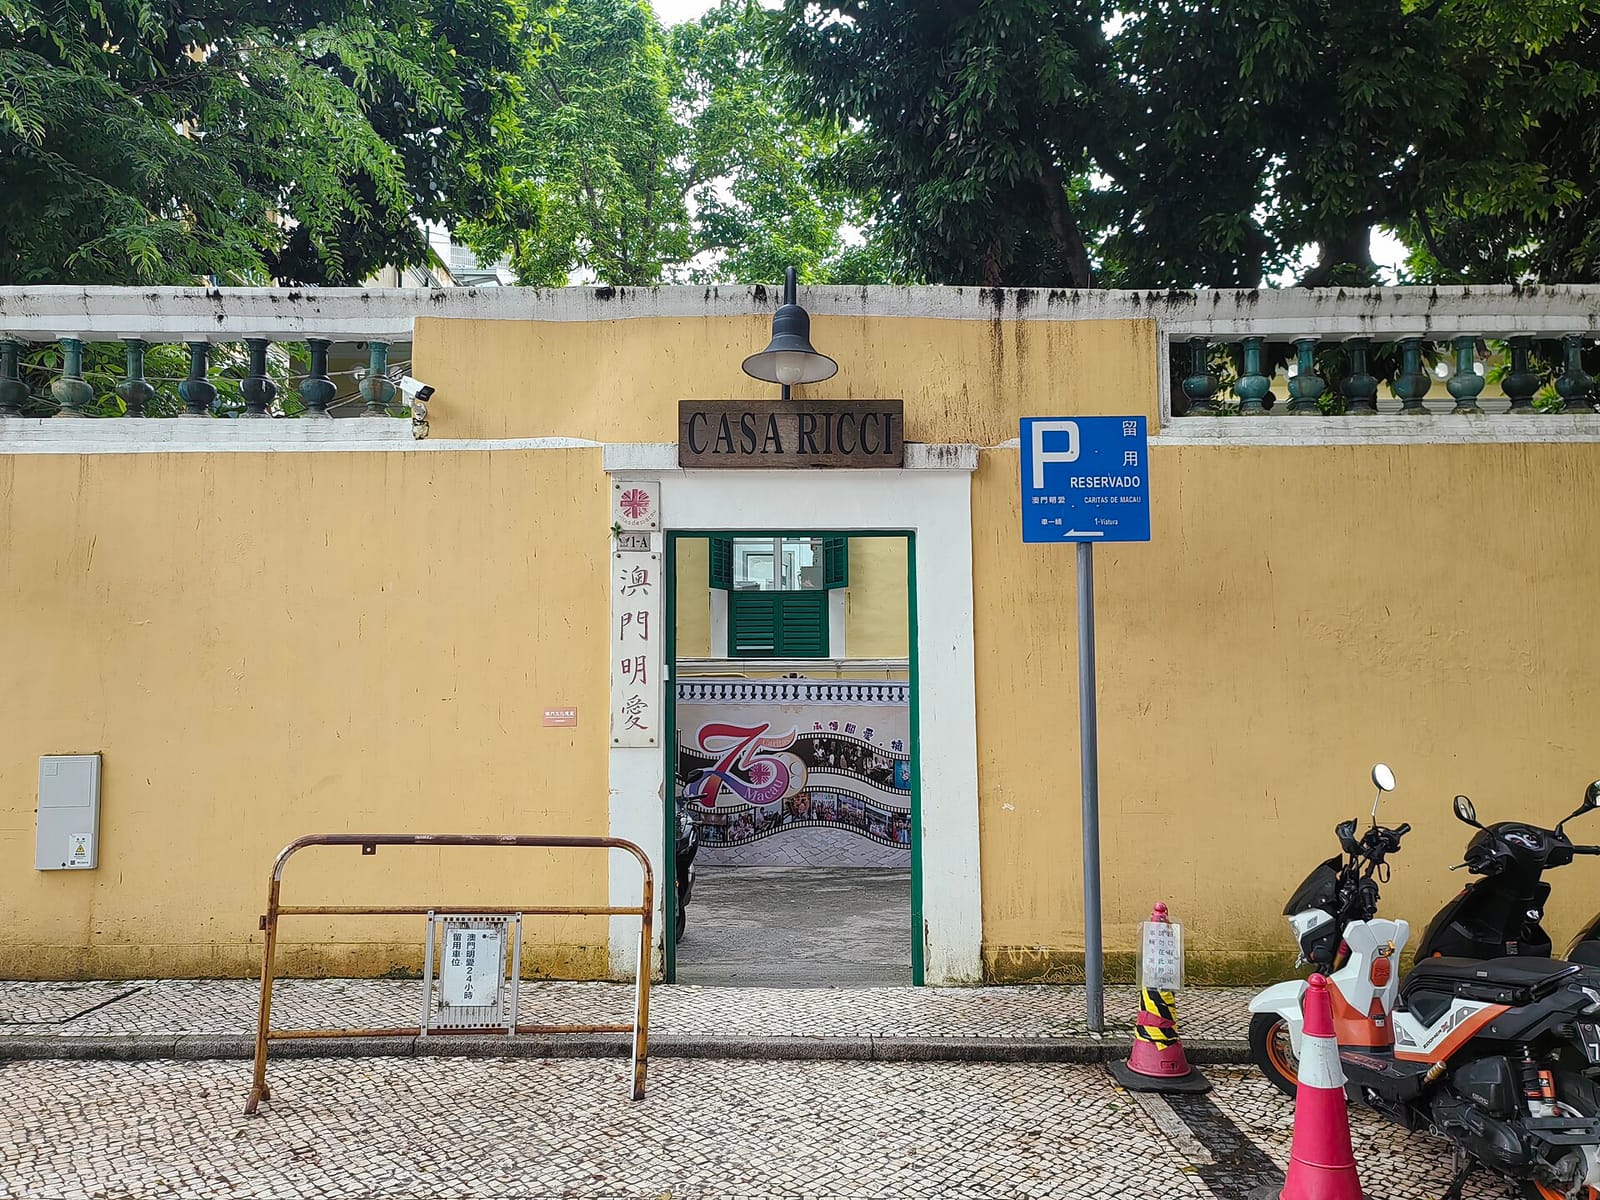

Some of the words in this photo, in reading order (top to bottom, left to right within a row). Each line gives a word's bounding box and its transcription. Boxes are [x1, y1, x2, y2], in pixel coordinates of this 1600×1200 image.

[687, 411, 784, 455] CASA
[796, 412, 894, 455] RICCI
[1122, 420, 1138, 467] 留用
[1032, 421, 1080, 489] P
[1070, 475, 1141, 489] RESERVADO
[1083, 496, 1109, 504] CARITAS
[1110, 496, 1118, 504] DE
[1119, 496, 1142, 504] MACAU
[619, 564, 653, 731] 澳門明愛
[744, 779, 785, 802] Macau
[451, 933, 463, 967] 留用車位
